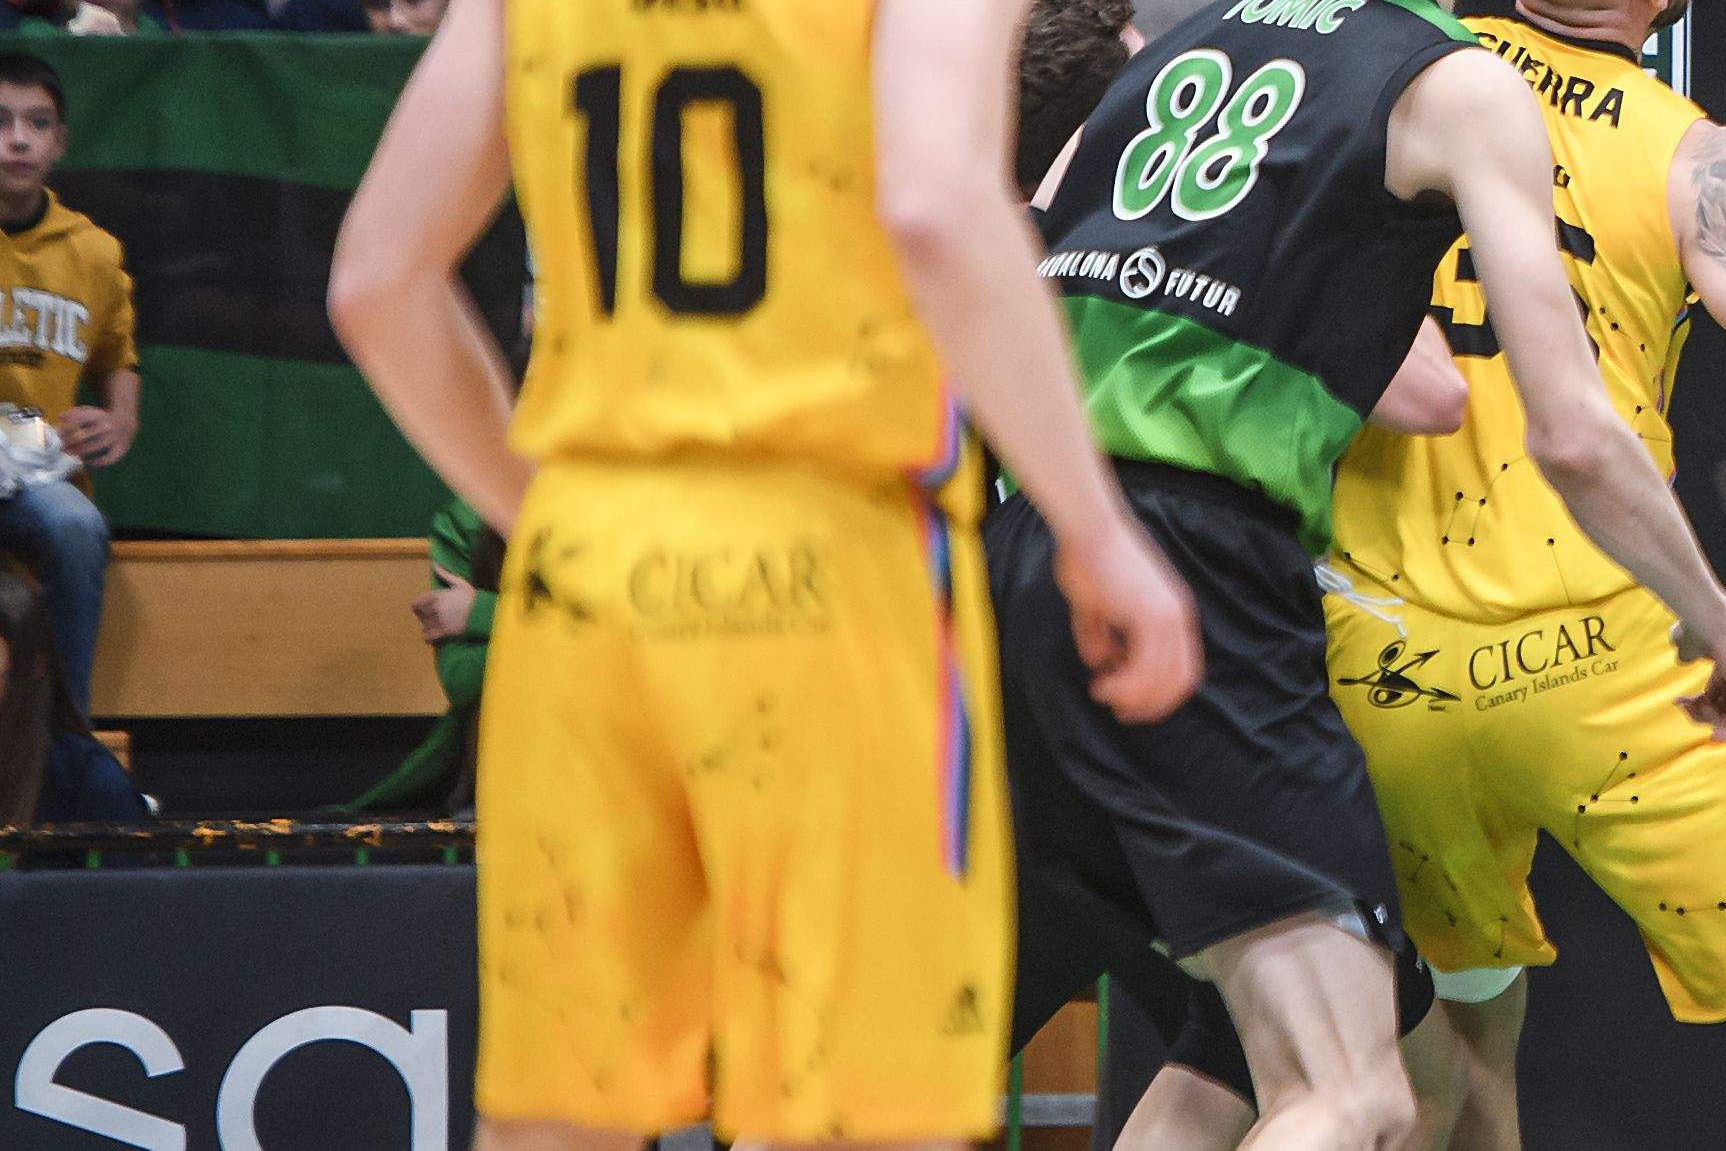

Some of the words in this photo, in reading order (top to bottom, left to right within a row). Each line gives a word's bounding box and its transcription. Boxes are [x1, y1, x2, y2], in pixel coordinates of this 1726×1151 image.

[1112, 48, 1306, 222] 88
[566, 63, 768, 319] 10
[1035, 251, 1121, 281] ADALONA
[1164, 268, 1242, 317] FUTUR
[1468, 615, 1617, 691] CICAR
[1474, 685, 1529, 712] Canary
[1532, 667, 1588, 694] Islands
[1591, 658, 1619, 676] Car
